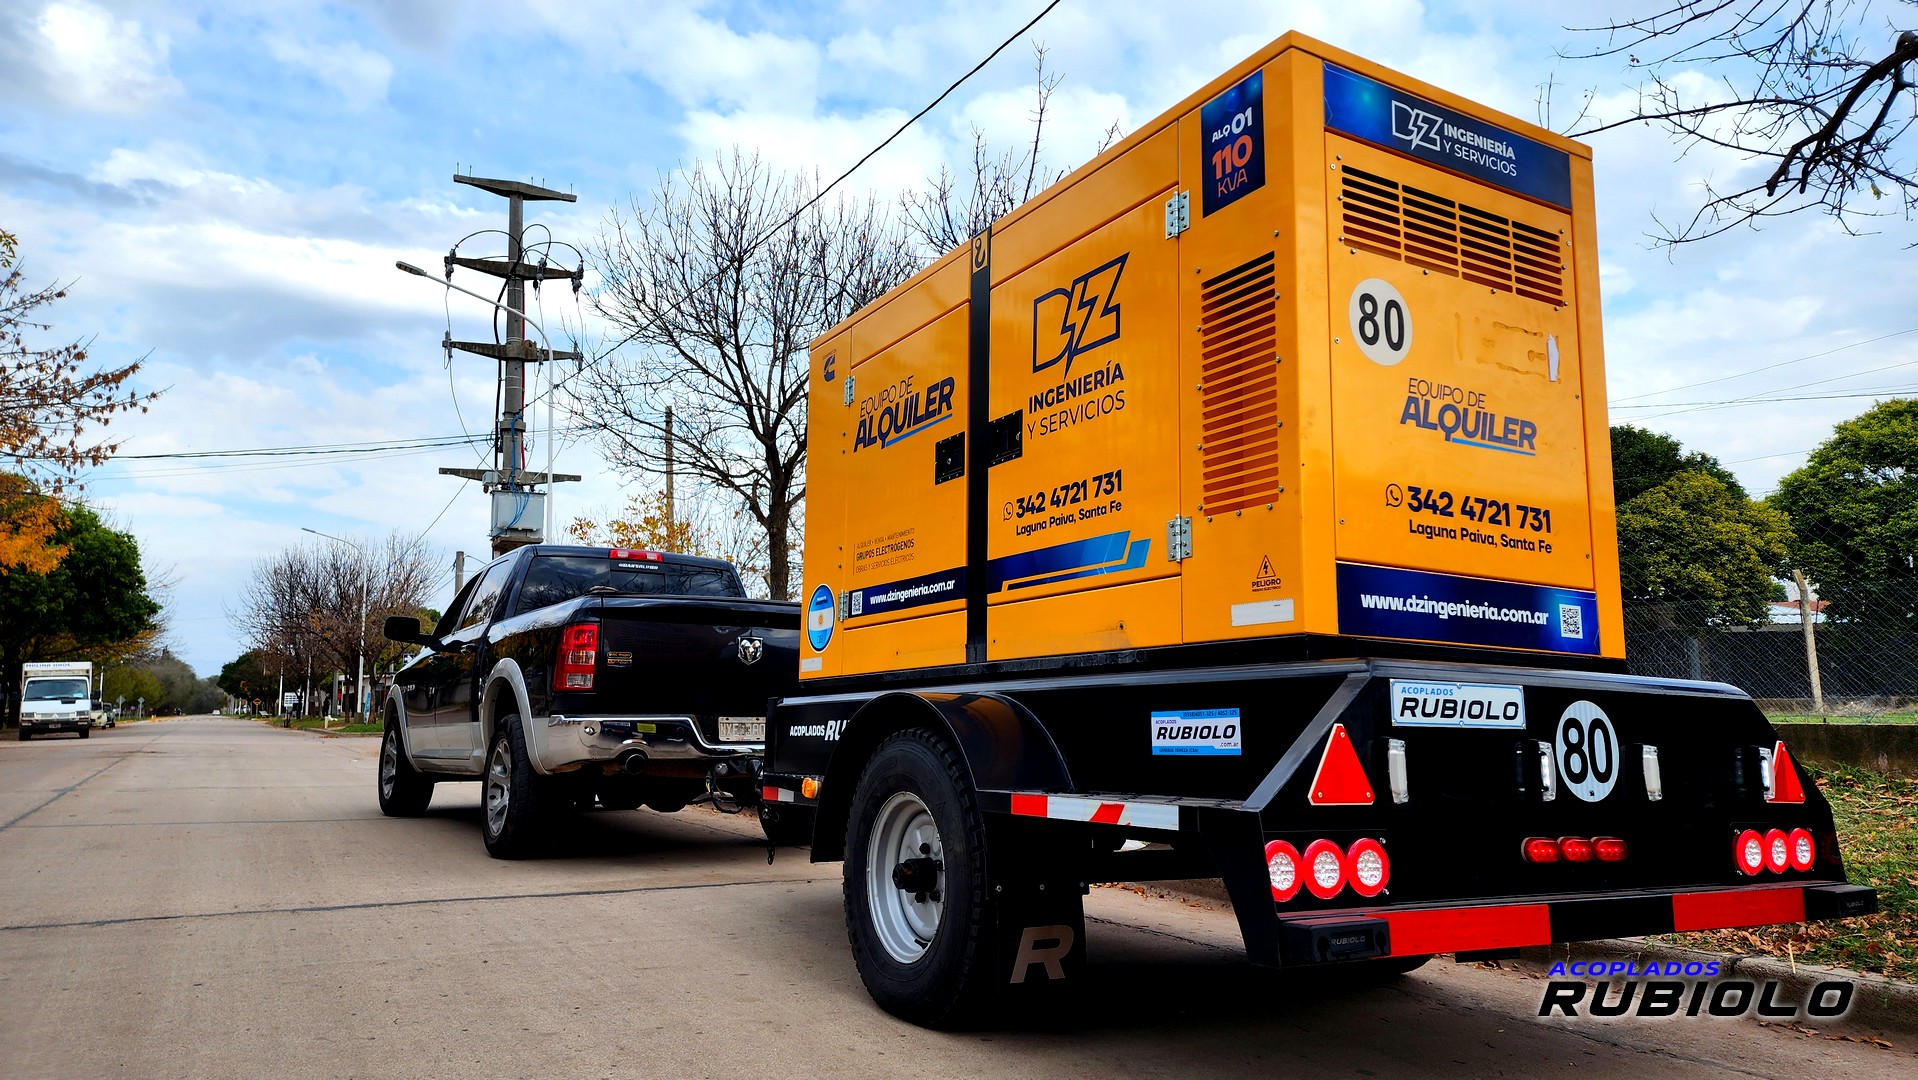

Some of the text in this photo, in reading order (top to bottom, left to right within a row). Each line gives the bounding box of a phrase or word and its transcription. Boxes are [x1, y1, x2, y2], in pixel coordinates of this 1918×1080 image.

[1212, 135, 1253, 180] 110
[1443, 139, 1518, 177] Y SERVICIOS
[1444, 122, 1516, 160] INGENIERÍA
[1218, 168, 1248, 198] KVA
[1359, 292, 1405, 351] 80
[859, 375, 915, 418] EQUIPO DE
[1028, 360, 1125, 414] INGENIERÍA
[1408, 378, 1487, 410] EQUIPO DE
[853, 376, 955, 453] ALQUILER
[1027, 390, 1126, 440] Y SERVICIOS
[1400, 396, 1537, 451] ALQUILER
[1015, 469, 1123, 519] 342 4721 731
[1407, 486, 1551, 534] 342 4721 731
[1016, 500, 1122, 537] Laguna Paiva, Santa Fe
[1409, 519, 1552, 554] Laguna Paiva, Santa Fe
[856, 549, 875, 561] GRUPOS
[870, 580, 955, 604] www.dzingenieria.com.ar
[1251, 578, 1281, 588] PELIGRO
[1361, 593, 1549, 626] www.dzingenieria.com.ar
[1400, 697, 1519, 721] RUBIOLO
[1401, 686, 1454, 696] ACOPLADOS
[790, 725, 825, 736] ACOPLADOS
[1156, 725, 1236, 740] RUBIOLO
[1562, 717, 1613, 784] 80
[1010, 925, 1074, 984] R
[1330, 935, 1366, 946] RUBIOLO
